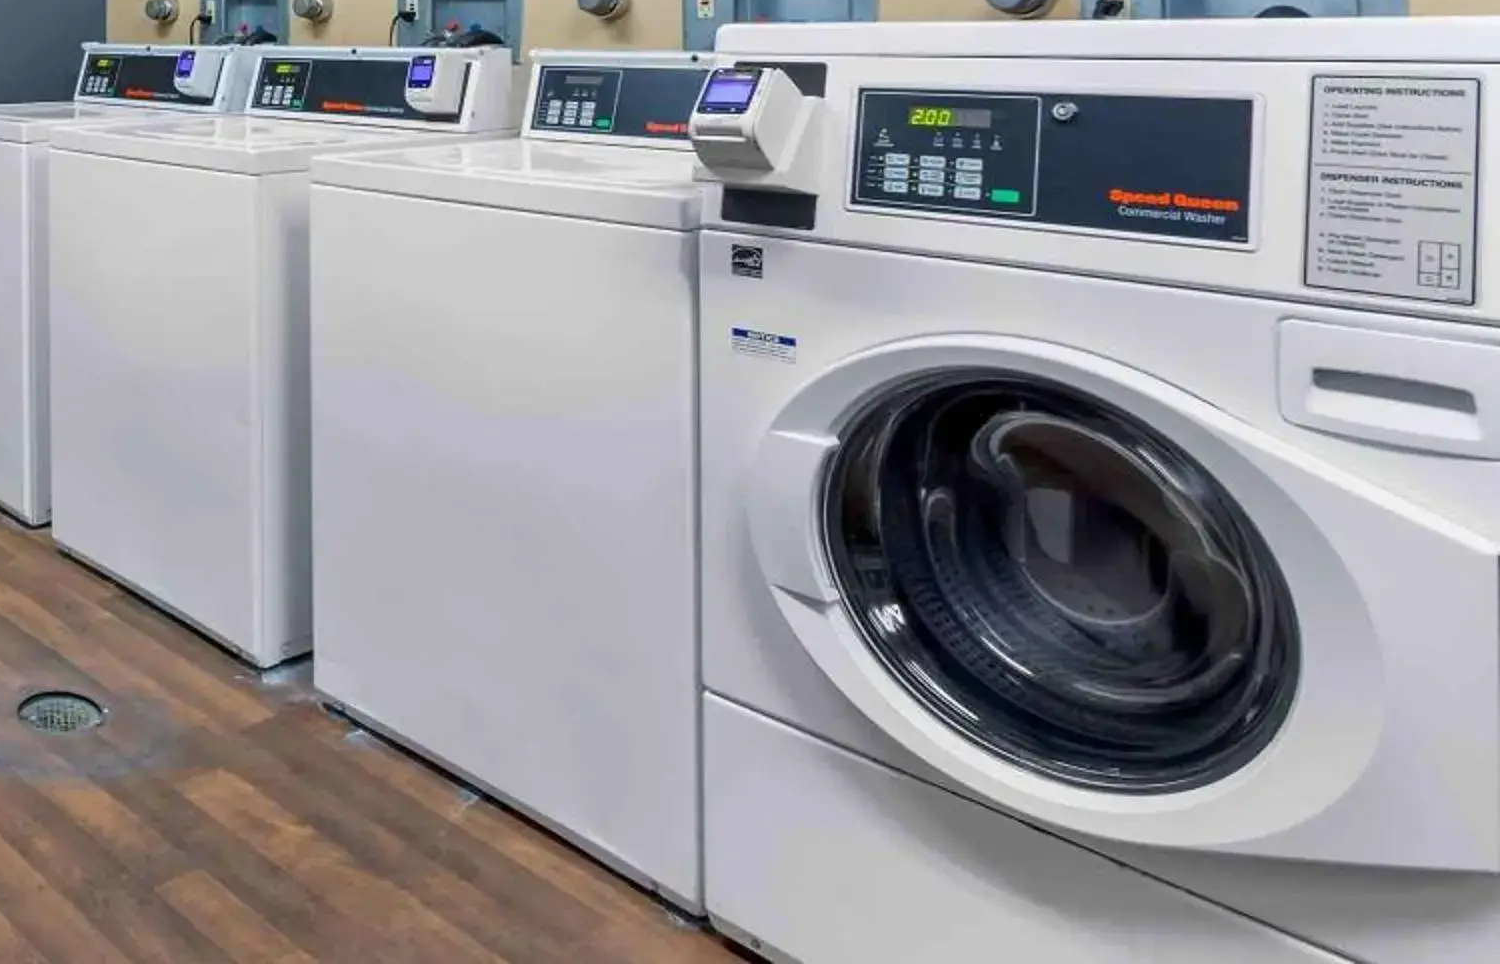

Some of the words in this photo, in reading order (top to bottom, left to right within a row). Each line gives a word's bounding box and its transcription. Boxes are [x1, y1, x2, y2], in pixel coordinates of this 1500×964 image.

[1323, 85, 1382, 96] OPERATING
[1385, 87, 1466, 97] INSTRUCTIONS
[1320, 172, 1379, 184] DISPENSER
[1382, 174, 1463, 189] INSTRUCTIONS
[1108, 188, 1171, 206] Speed
[1173, 193, 1240, 212] Queen
[1117, 205, 1181, 221] Commercial
[1183, 210, 1227, 225] Washer
